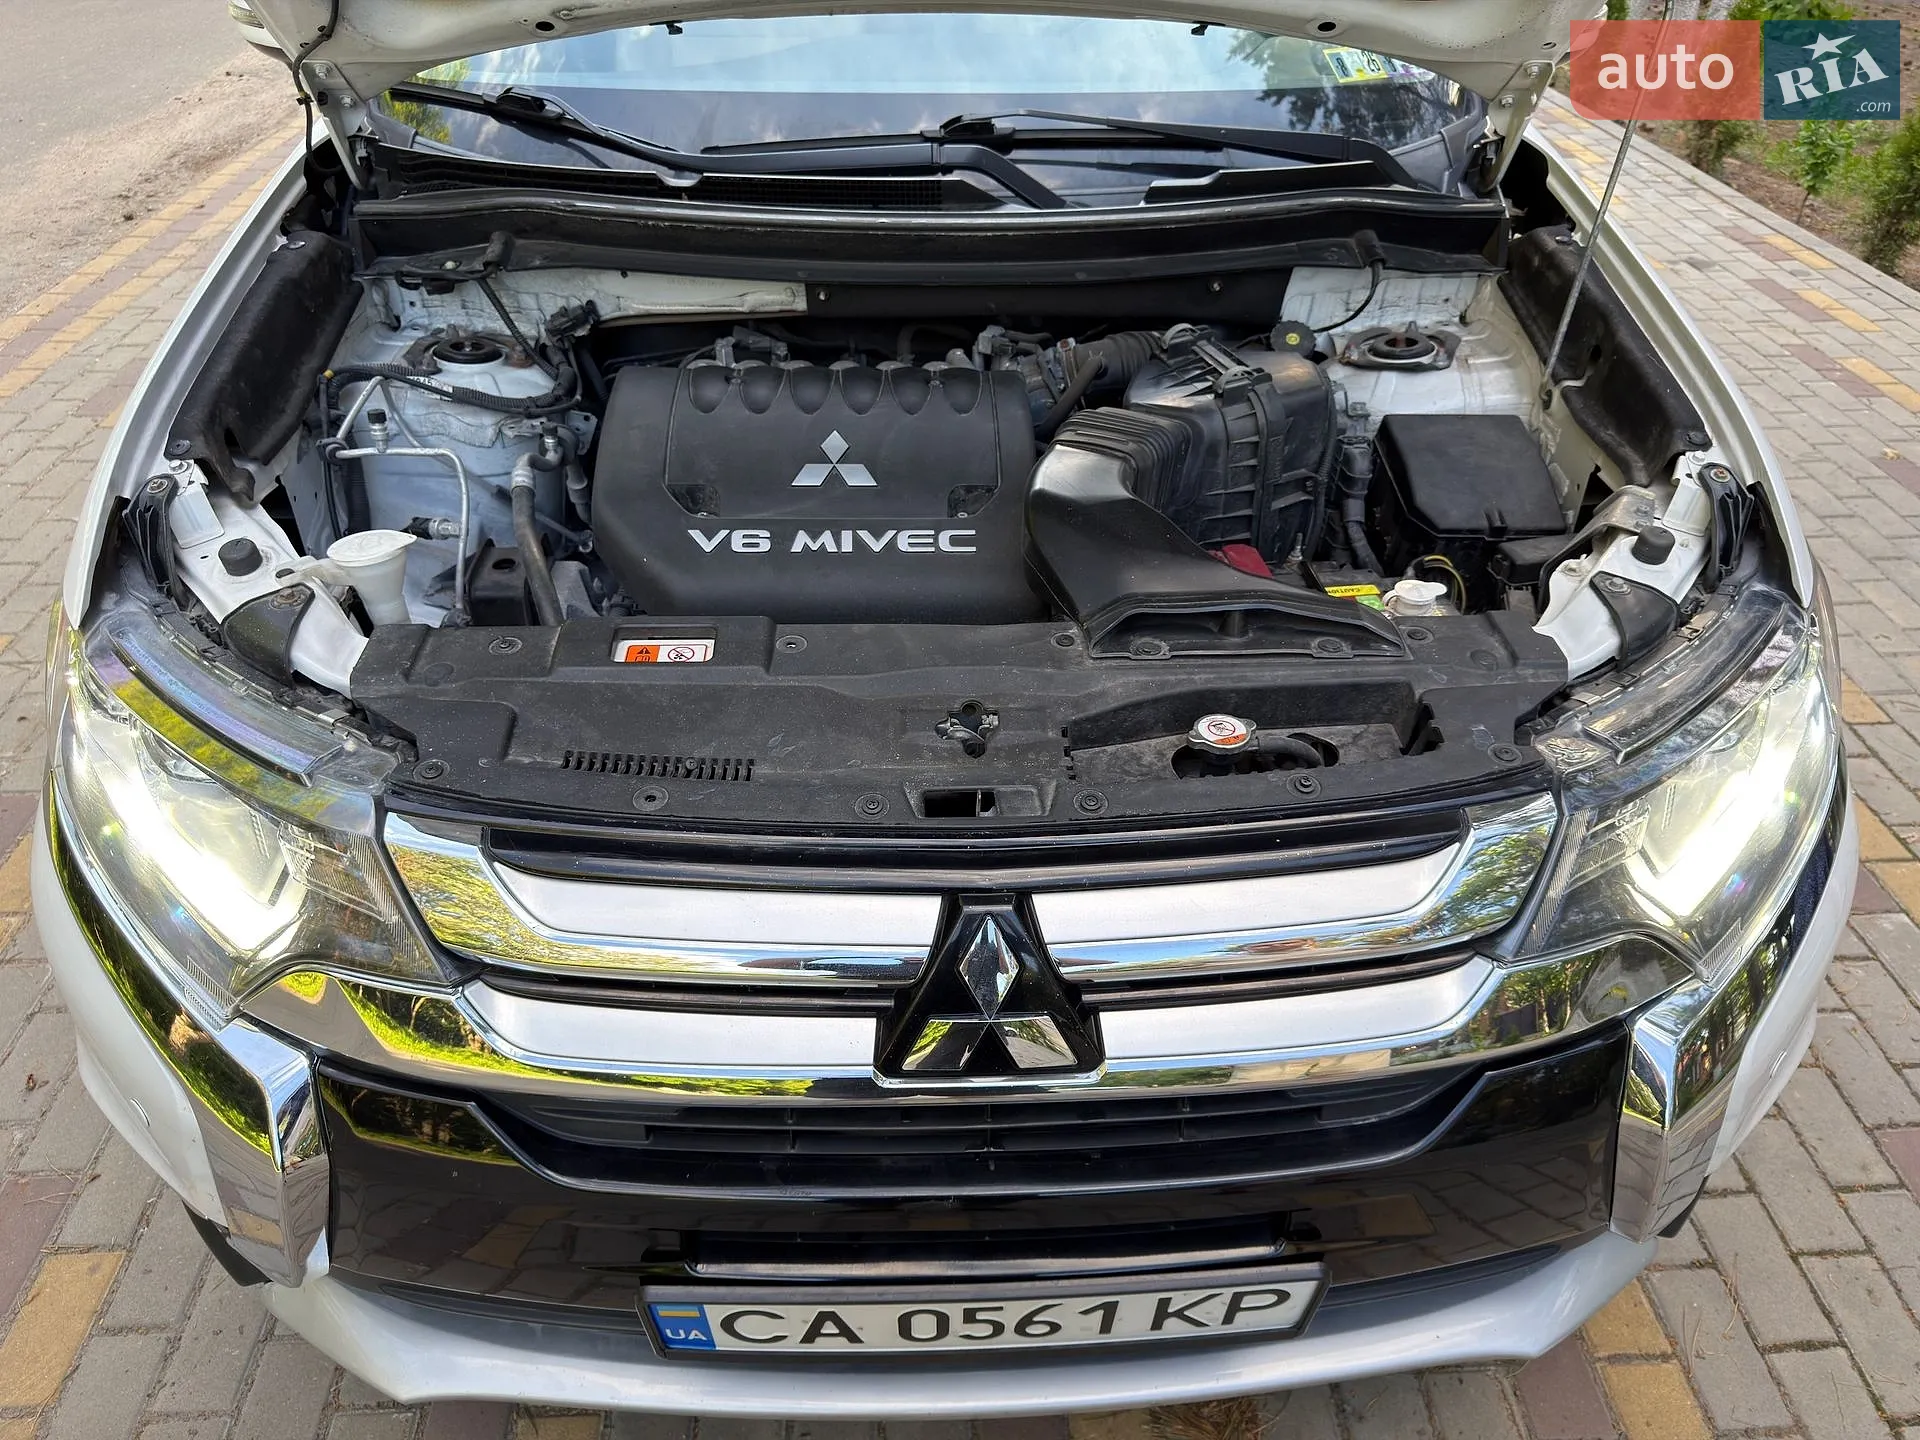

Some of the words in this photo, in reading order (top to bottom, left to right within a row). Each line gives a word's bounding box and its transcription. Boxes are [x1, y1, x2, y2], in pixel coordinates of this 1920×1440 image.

[687, 529, 771, 553] V6
[790, 529, 977, 553] MIVEC
[719, 1310, 865, 1344] CA
[897, 1300, 1119, 1343] 0561
[1149, 1288, 1292, 1331] KP
[665, 1328, 707, 1341] UA
